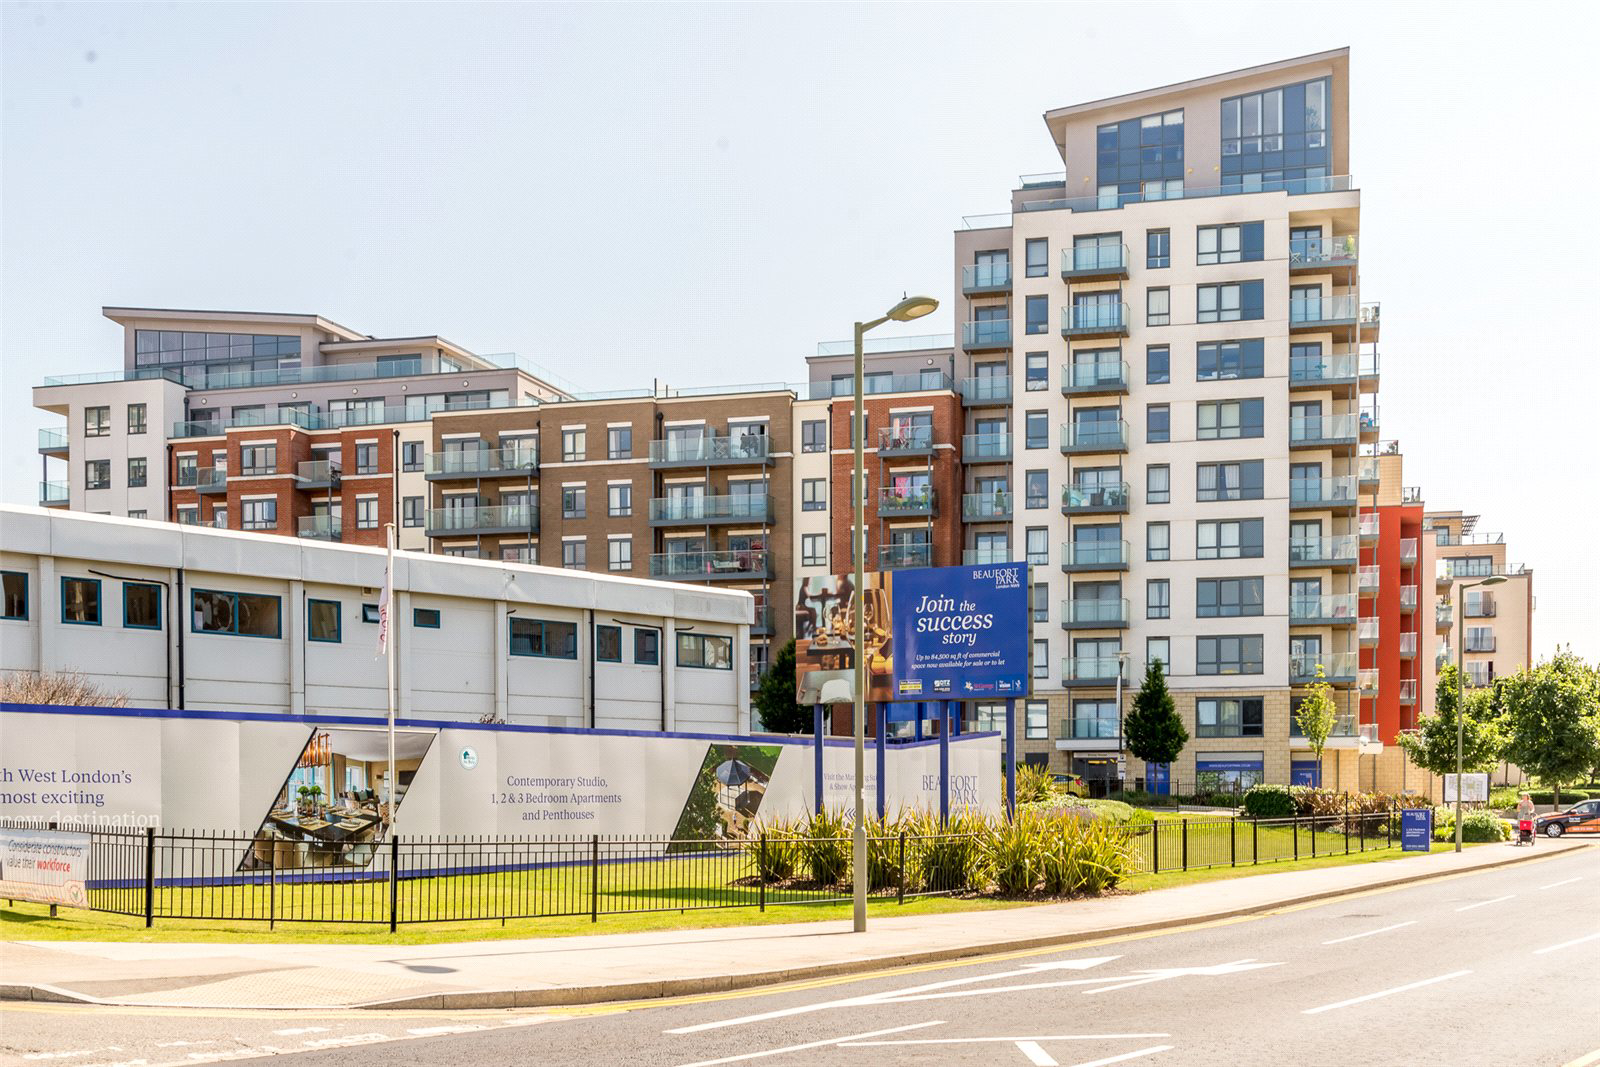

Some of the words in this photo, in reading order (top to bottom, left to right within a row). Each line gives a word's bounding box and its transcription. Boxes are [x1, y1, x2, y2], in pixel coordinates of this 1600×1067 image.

[972, 568, 1019, 580] BEAUFORT
[995, 575, 1019, 585] PARK
[915, 594, 955, 614] Join
[959, 600, 976, 612] the
[916, 613, 993, 633] success
[942, 631, 977, 646] story
[962, 652, 969, 660] of
[969, 651, 1000, 659] commercial
[938, 660, 963, 668] available
[18, 769, 57, 783] West
[61, 769, 132, 783] London's
[507, 775, 576, 789] Contemporary
[577, 776, 608, 788] Studio,
[922, 775, 978, 791] BEAFORT
[41, 790, 105, 807] exciting
[491, 793, 499, 804] 1,
[501, 793, 507, 803] 2
[508, 793, 516, 803] &
[517, 793, 524, 803] 3
[525, 793, 568, 803] Bedroom
[570, 793, 622, 805] Apartments
[951, 789, 978, 804] PARK
[48, 810, 160, 828] destination
[522, 810, 540, 820] and
[542, 809, 595, 820] Penthouses
[8, 840, 42, 855] Considerate
[42, 843, 82, 857] constructors
[37, 858, 71, 872] workforce
